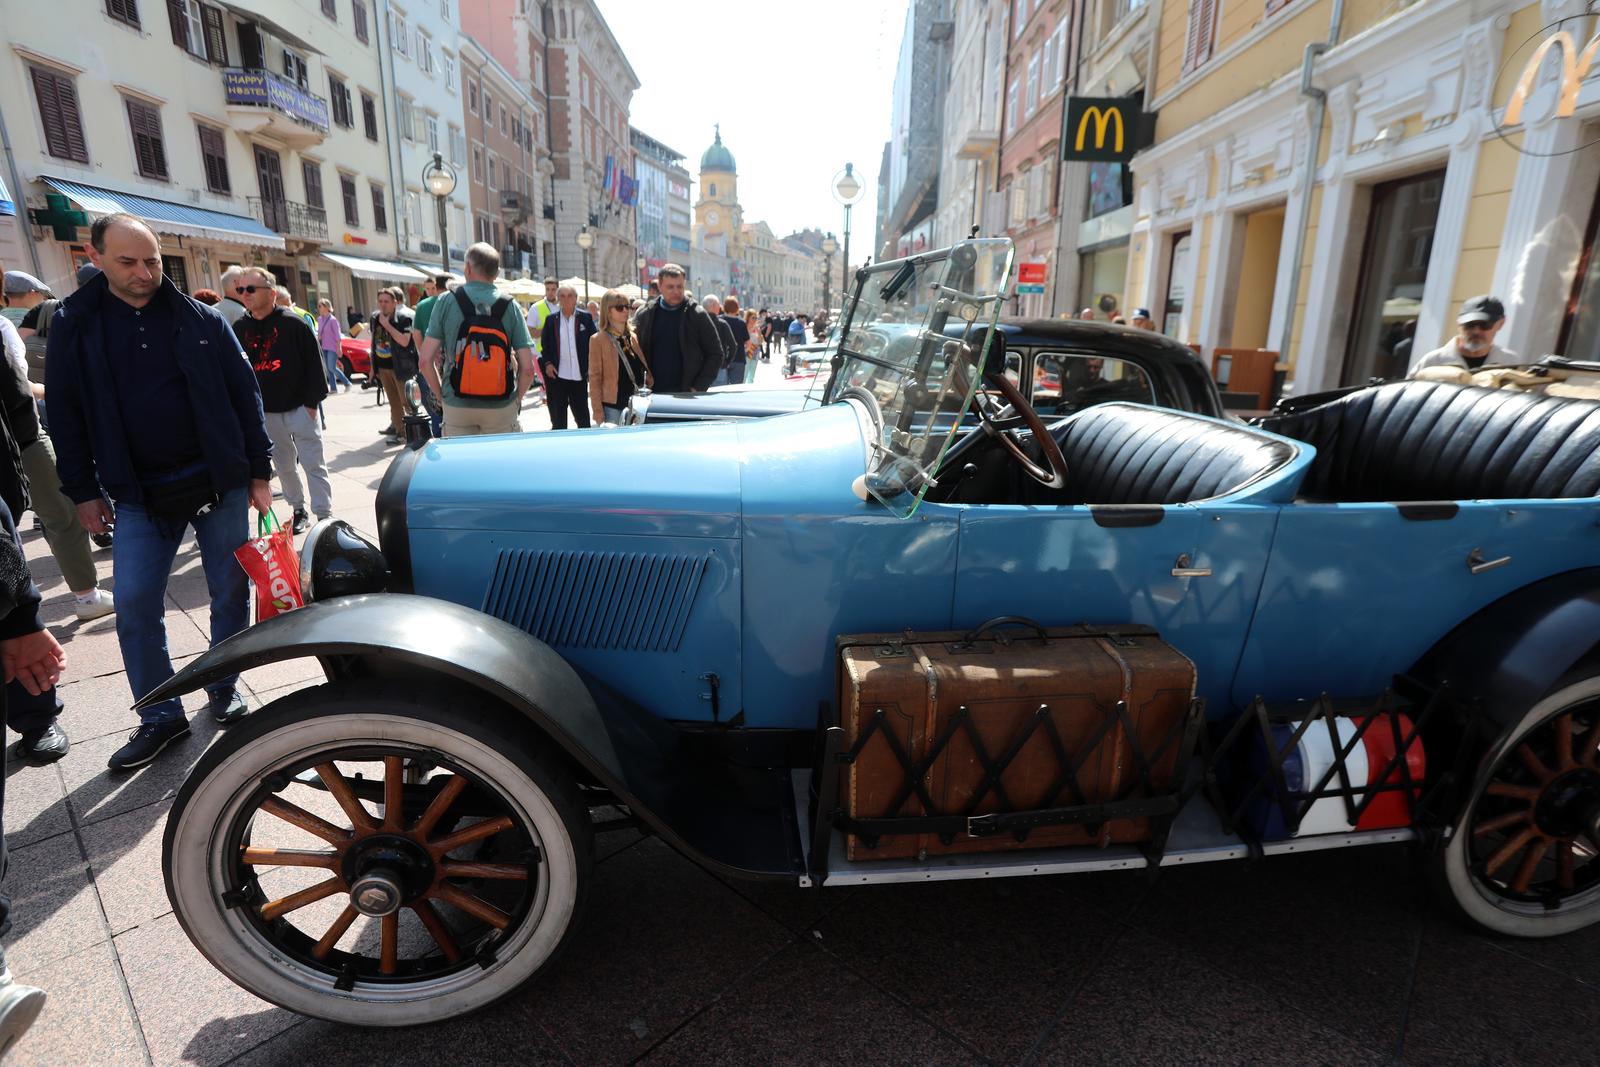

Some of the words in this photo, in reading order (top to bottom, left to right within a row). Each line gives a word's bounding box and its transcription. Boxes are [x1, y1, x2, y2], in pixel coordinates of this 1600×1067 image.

[228, 75, 263, 85] HAPPY
[228, 87, 266, 96] HOSTEL
[271, 87, 295, 106] HAPPY
